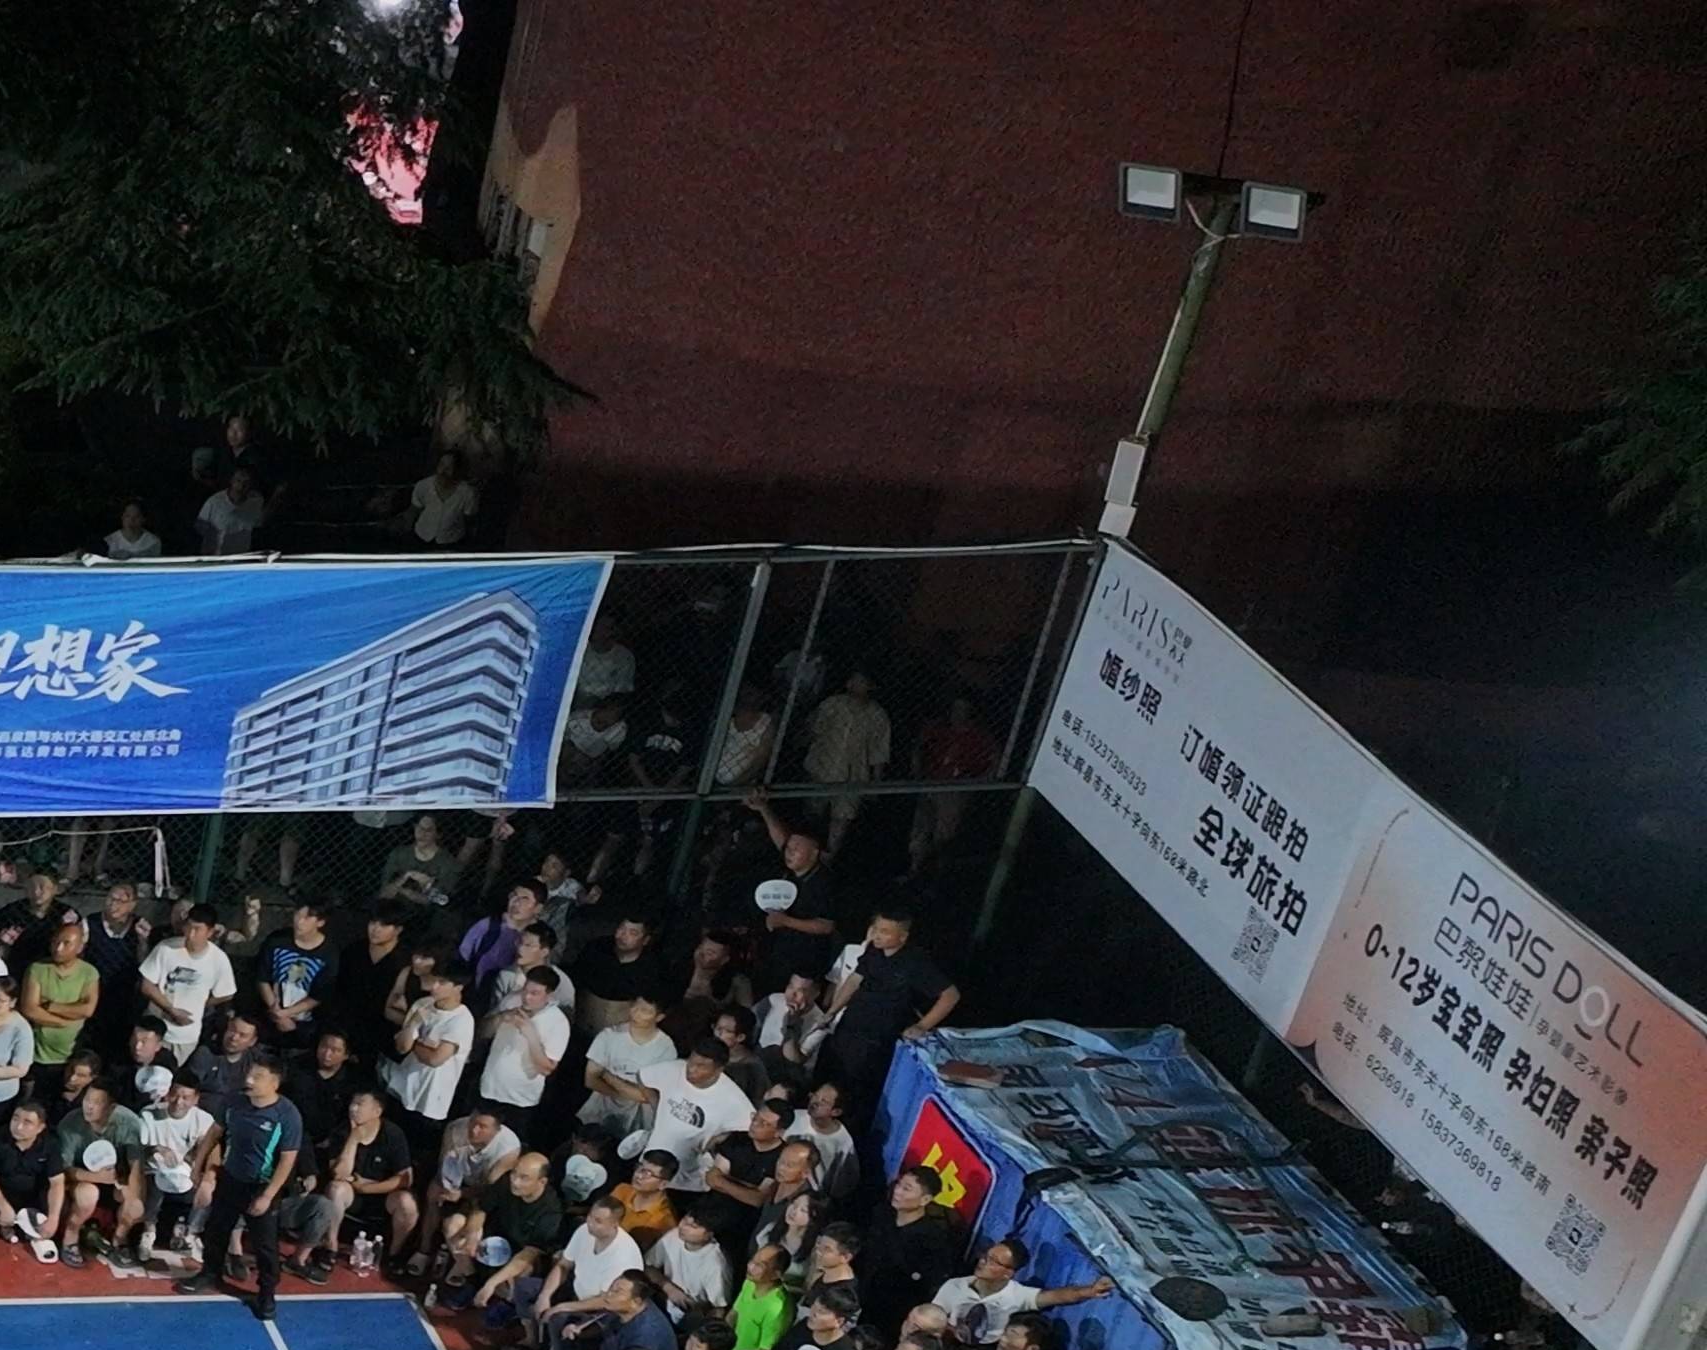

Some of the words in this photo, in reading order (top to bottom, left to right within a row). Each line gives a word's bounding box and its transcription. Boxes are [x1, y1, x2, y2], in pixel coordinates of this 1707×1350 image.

[1099, 648, 1163, 726] 婚纱照
[1179, 724, 1309, 863] 订婚领证跟拍
[1191, 804, 1309, 937] 全球旅拍
[1434, 916, 1535, 1023] 巴黎娃娃
[1449, 872, 1554, 979] PARIS
[1552, 960, 1644, 1068] DOLL
[1504, 1050, 1581, 1141] 孕妇照
[1574, 1115, 1659, 1212] 亲子照
